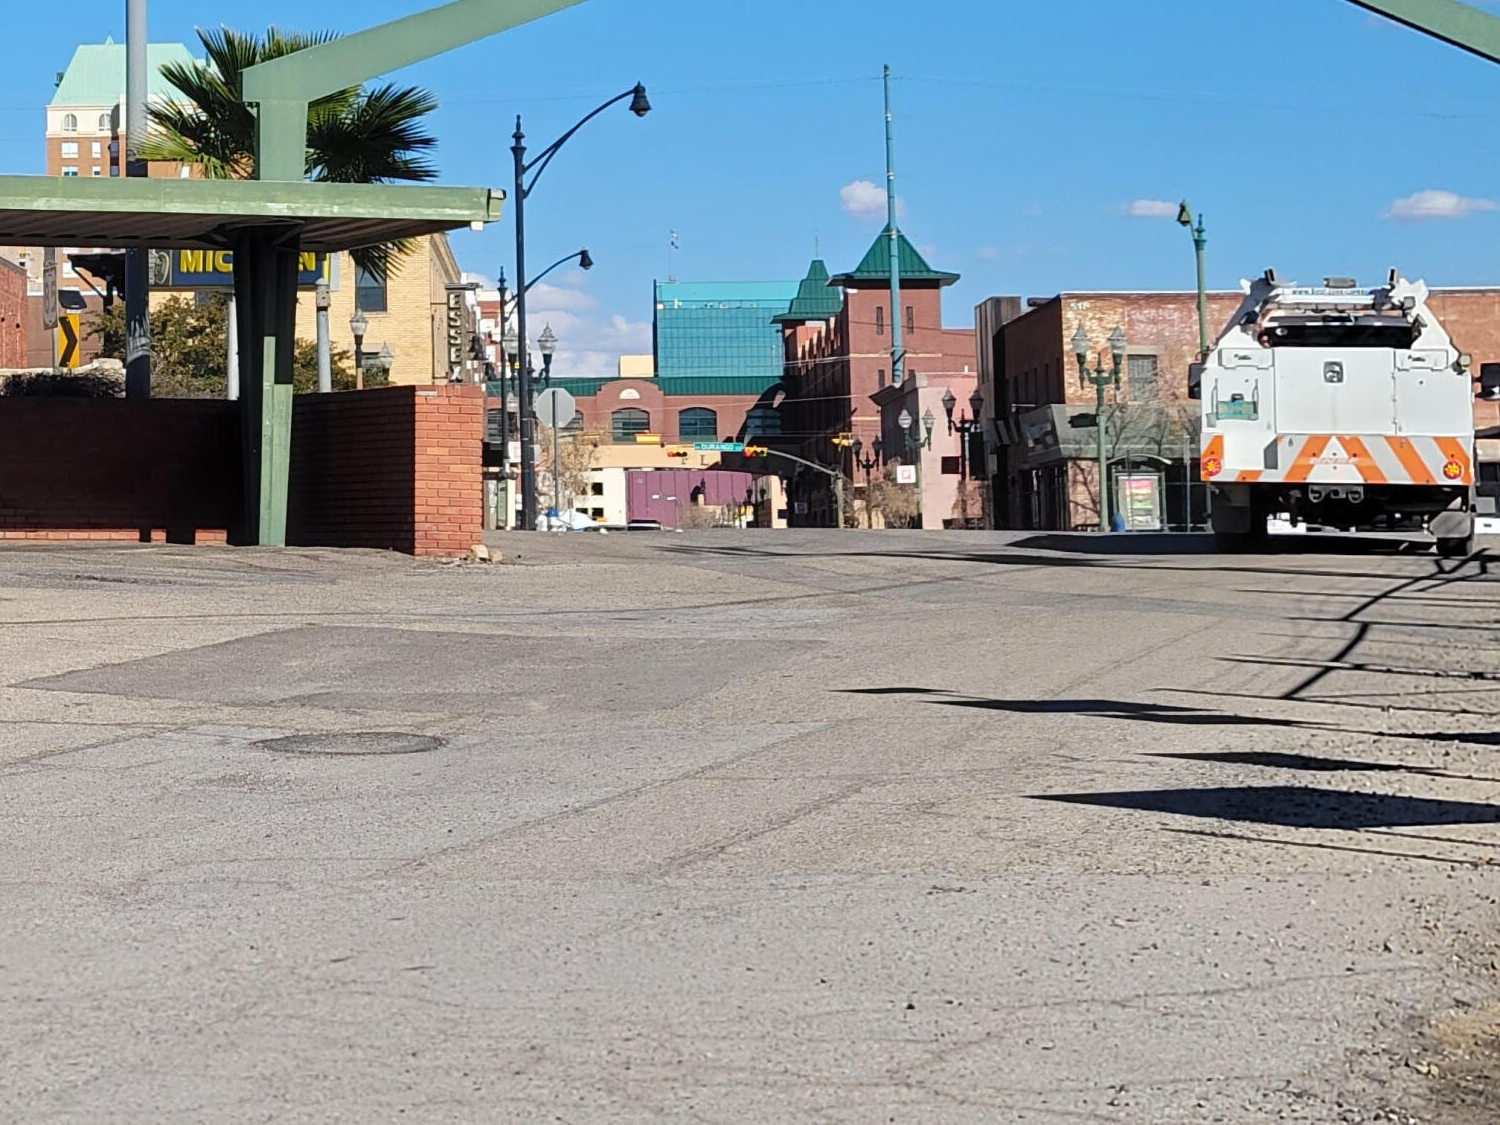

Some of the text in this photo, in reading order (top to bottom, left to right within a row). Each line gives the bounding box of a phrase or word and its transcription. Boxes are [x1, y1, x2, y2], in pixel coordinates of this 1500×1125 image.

[180, 250, 316, 273] MICN
[449, 293, 462, 380] ESSEX
[701, 443, 733, 451] DURANGO
